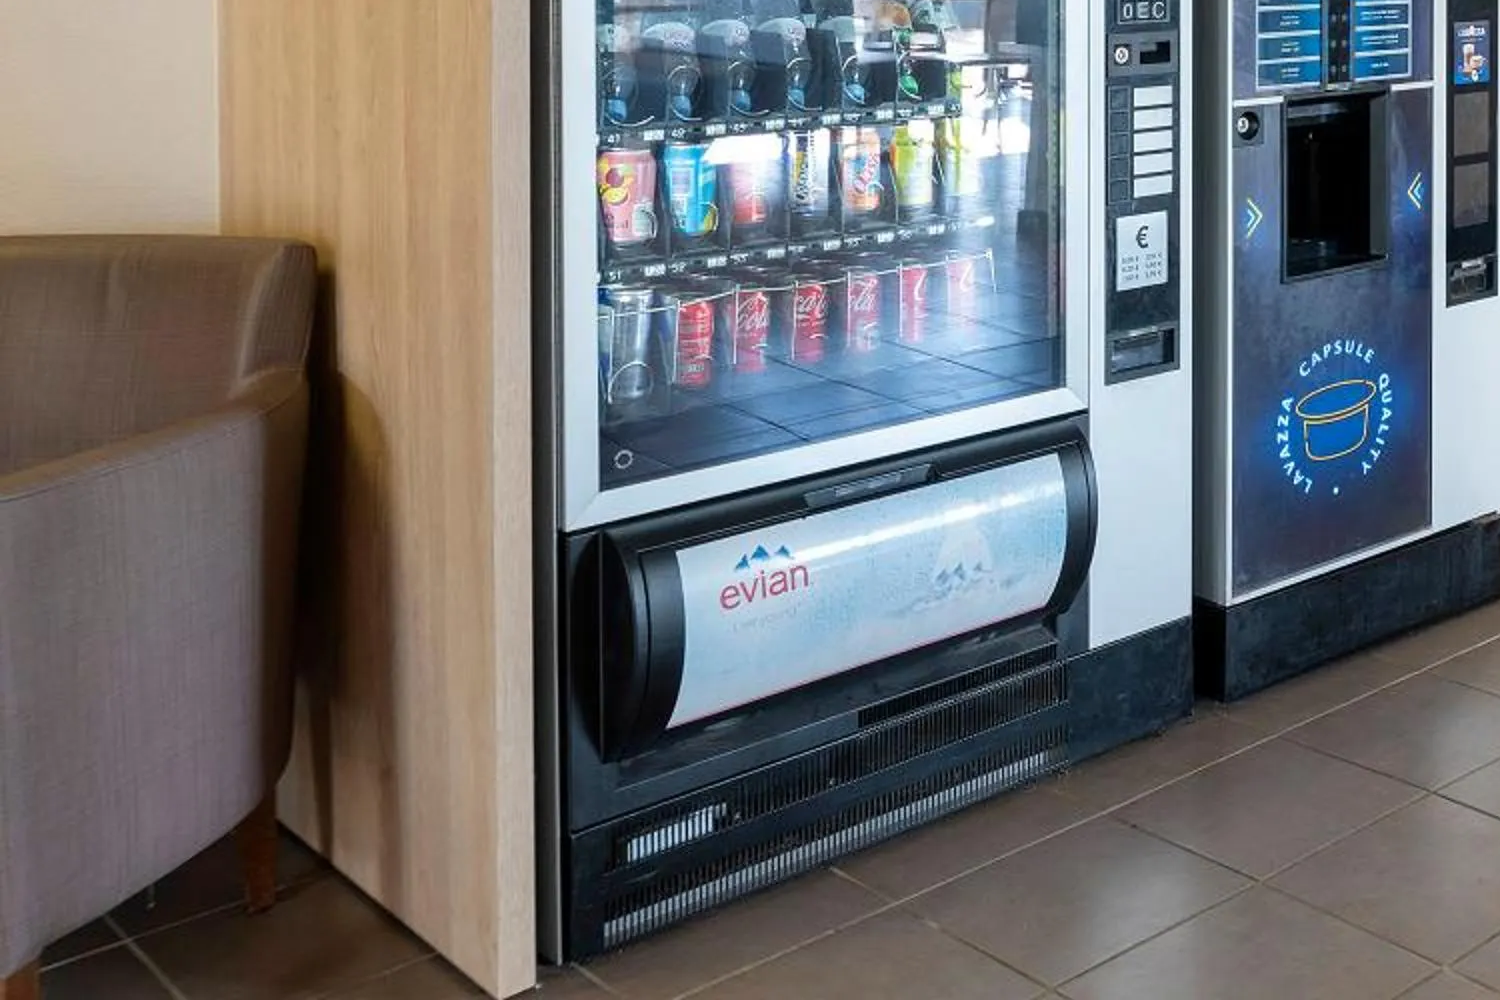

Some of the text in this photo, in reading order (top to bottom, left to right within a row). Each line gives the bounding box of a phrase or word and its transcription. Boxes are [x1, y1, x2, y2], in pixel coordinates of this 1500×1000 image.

[1123, 2, 1165, 19] 0 E C
[1299, 339, 1393, 475] CAPSULE QUALITY
[1277, 397, 1313, 493] LAVAZZA
[719, 563, 810, 611] evian
